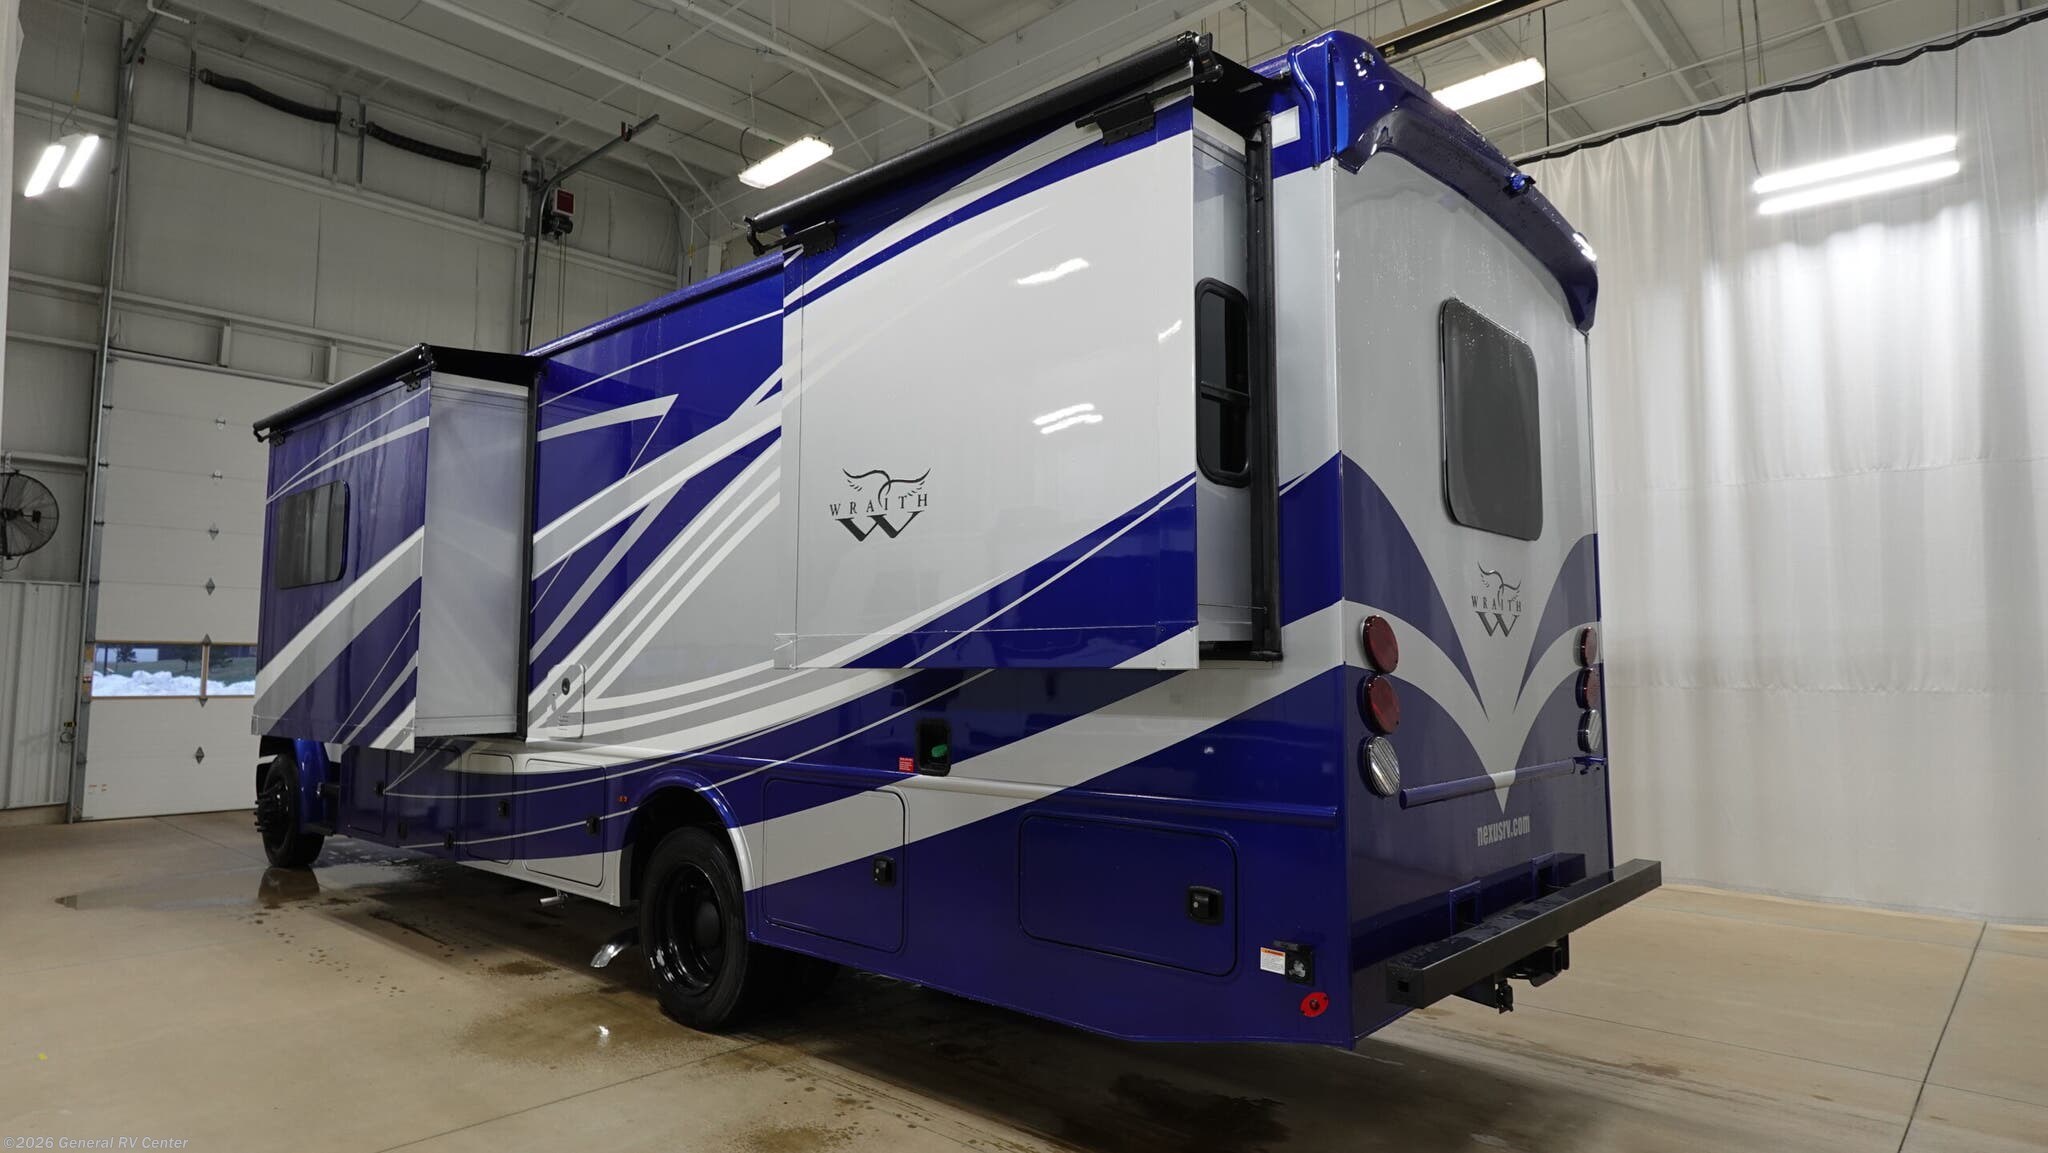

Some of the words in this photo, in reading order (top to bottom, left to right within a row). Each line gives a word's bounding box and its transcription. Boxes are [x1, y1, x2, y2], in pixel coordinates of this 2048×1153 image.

[829, 493, 928, 517] WRAITH
[1471, 594, 1522, 613] WRAITH
[1477, 815, 1531, 847] nexusrv.com
